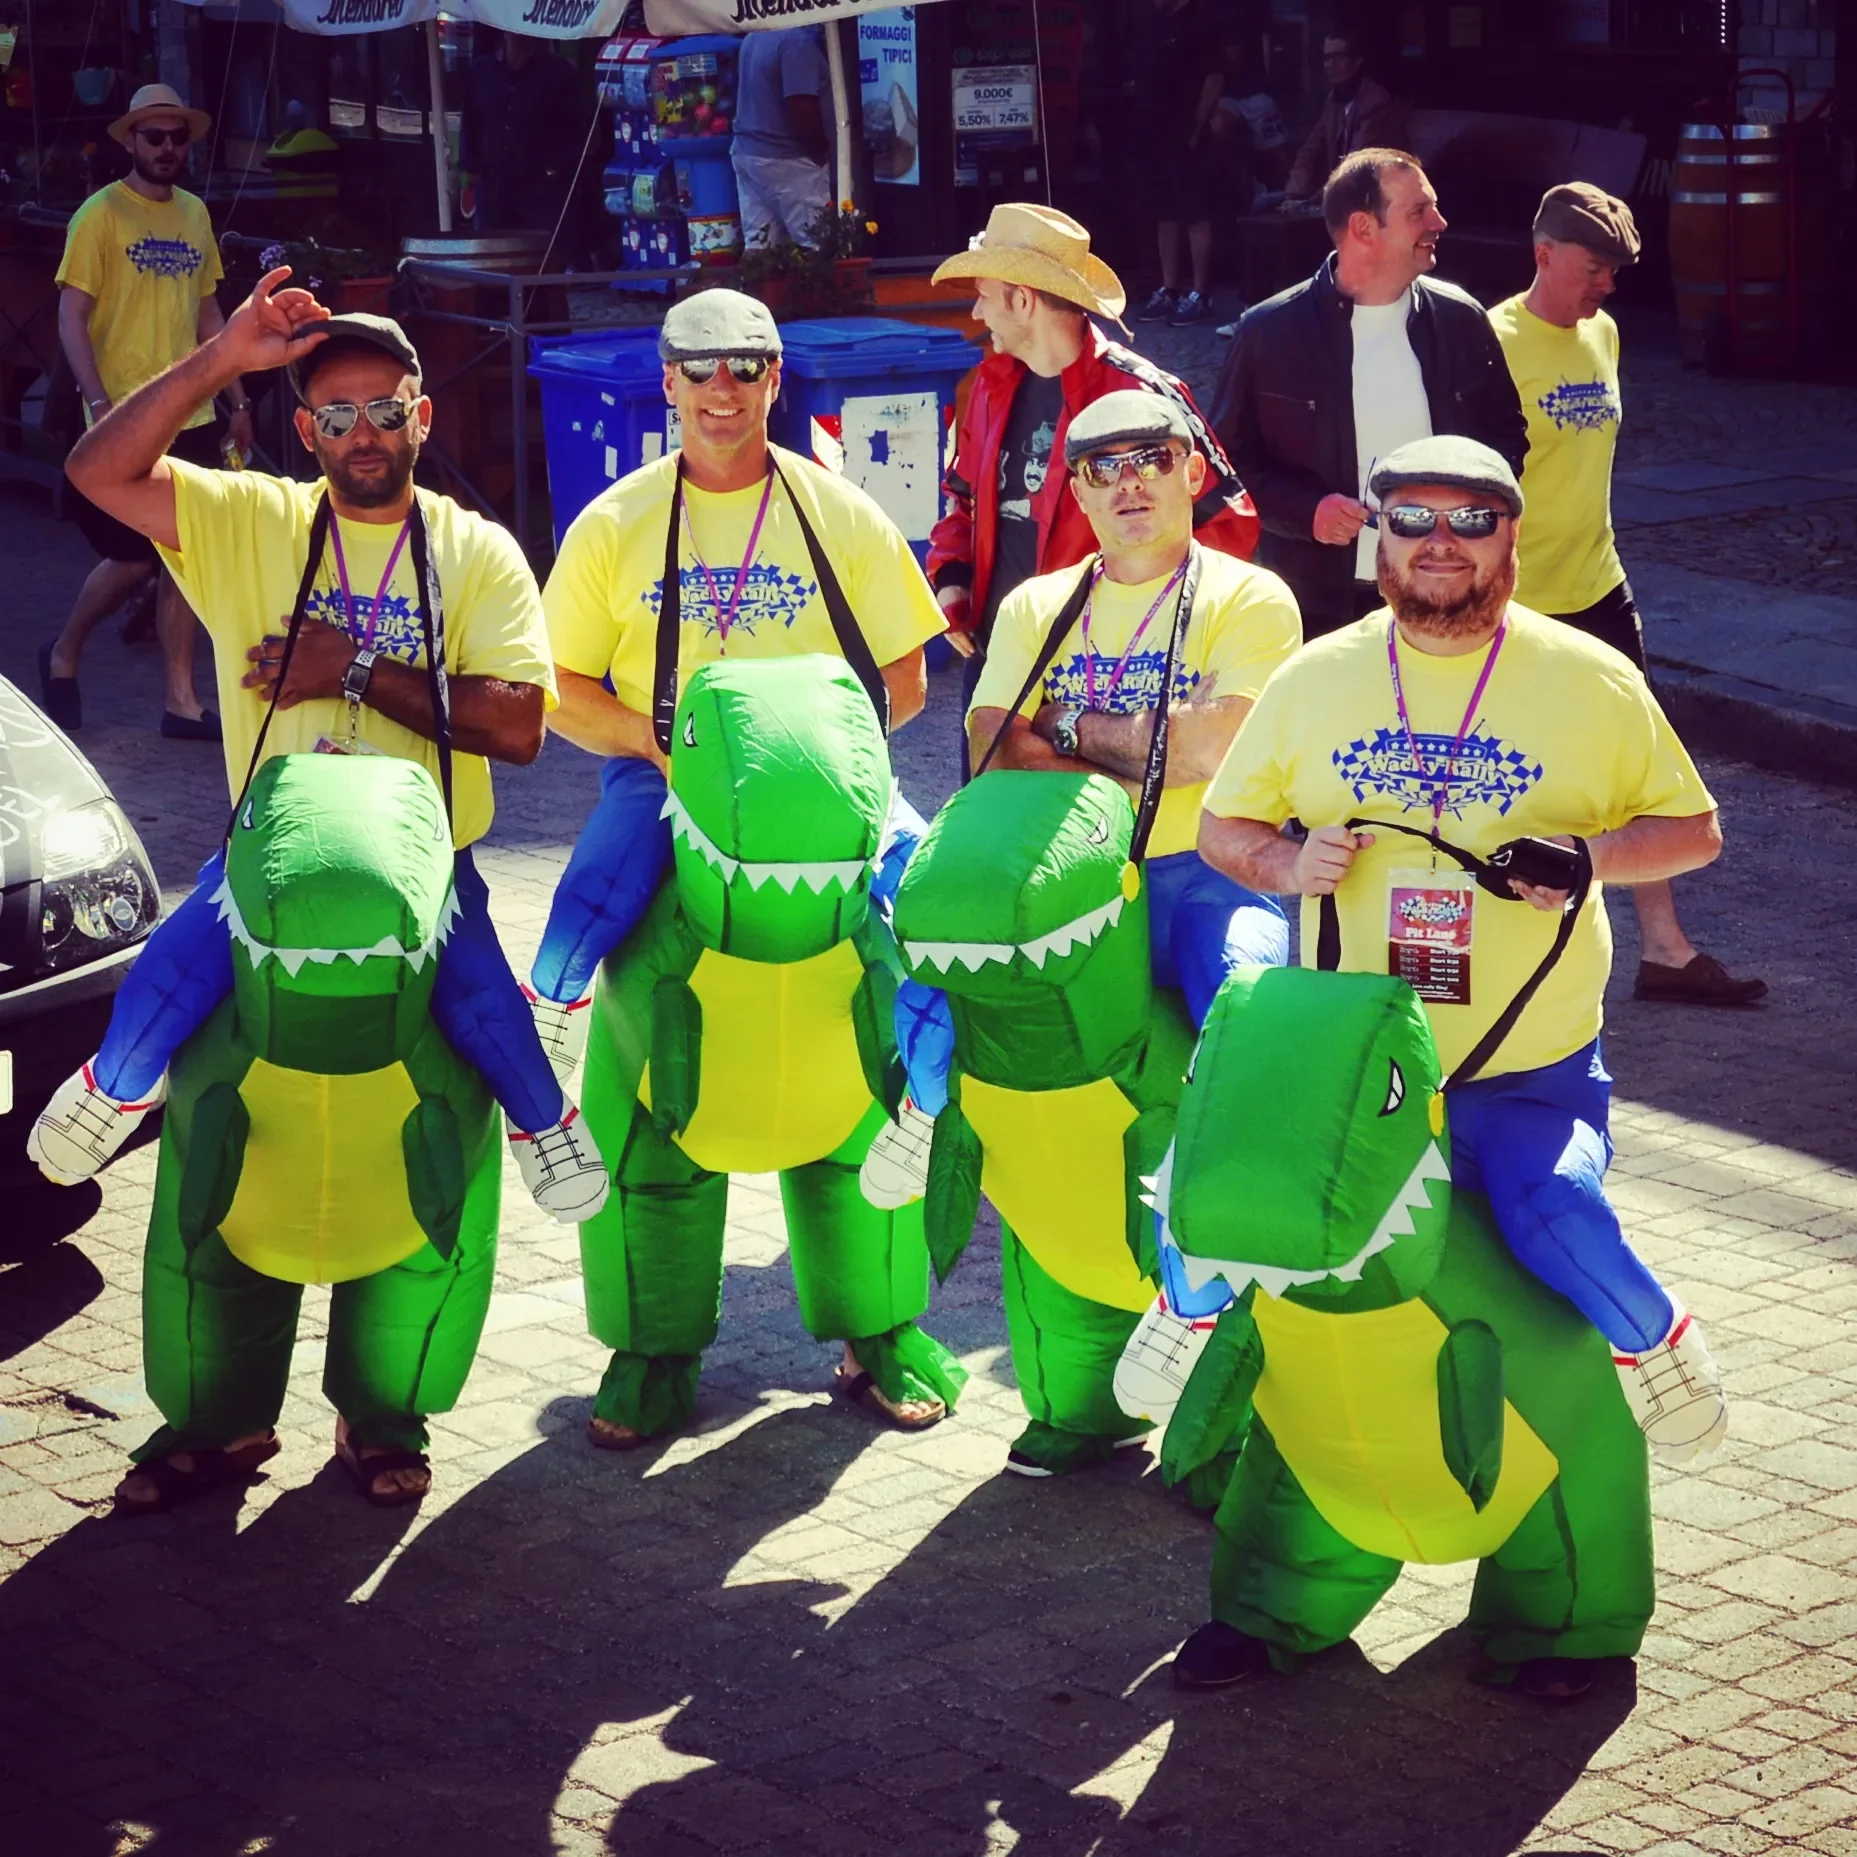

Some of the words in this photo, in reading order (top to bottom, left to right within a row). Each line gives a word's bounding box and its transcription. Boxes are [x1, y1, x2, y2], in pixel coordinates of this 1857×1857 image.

[860, 25, 912, 41] FORMAGGI
[882, 48, 912, 63] TIPICI
[1446, 757, 1498, 786] Rally
